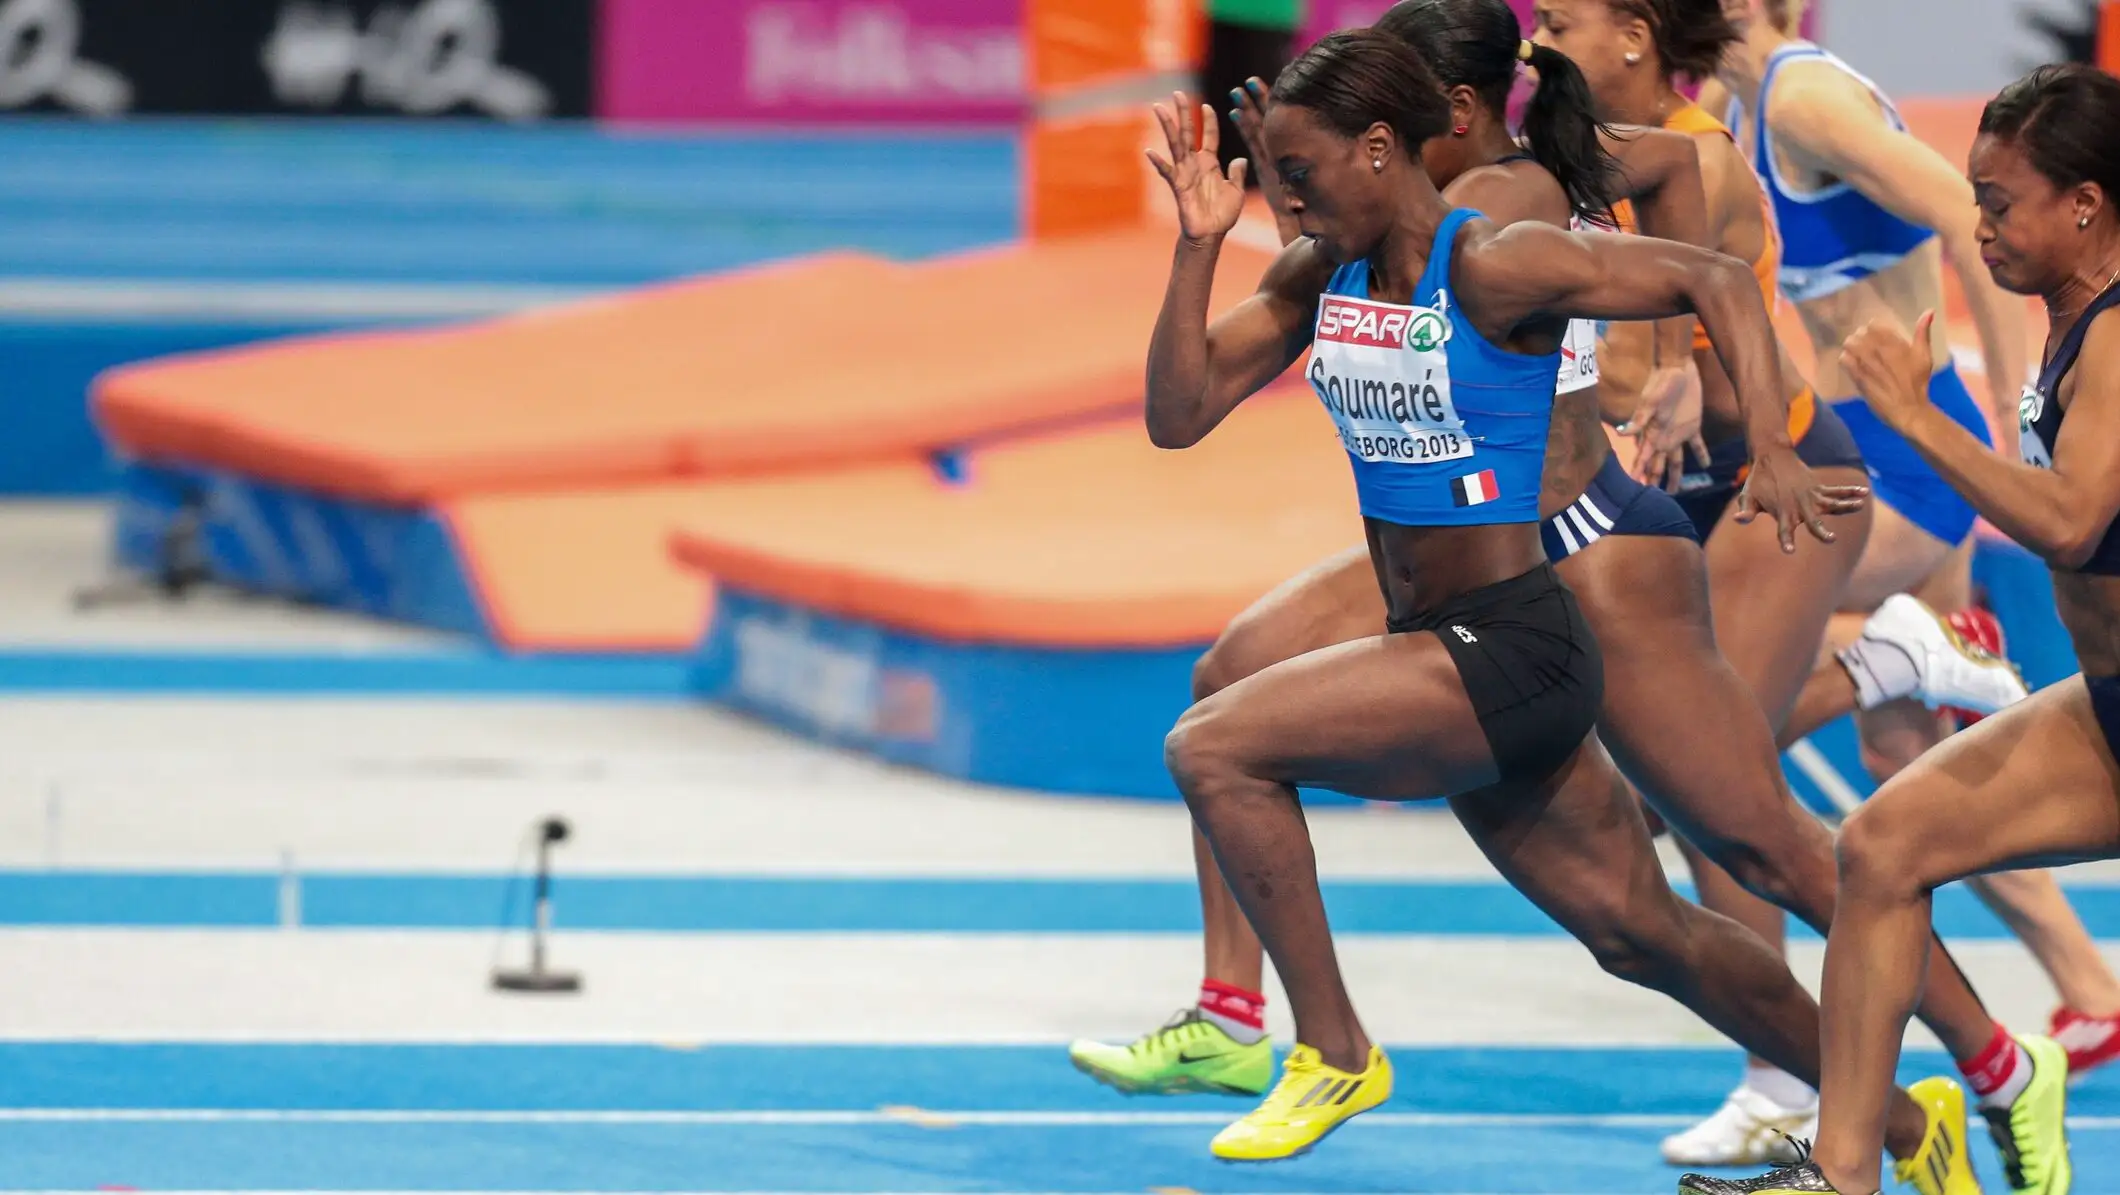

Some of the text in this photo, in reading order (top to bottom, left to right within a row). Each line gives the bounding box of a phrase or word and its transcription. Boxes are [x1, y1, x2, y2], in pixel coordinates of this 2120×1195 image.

[1319, 305, 1406, 343] SPAR
[1311, 356, 1445, 424] Soumaré
[1415, 433, 1461, 458] 2013
